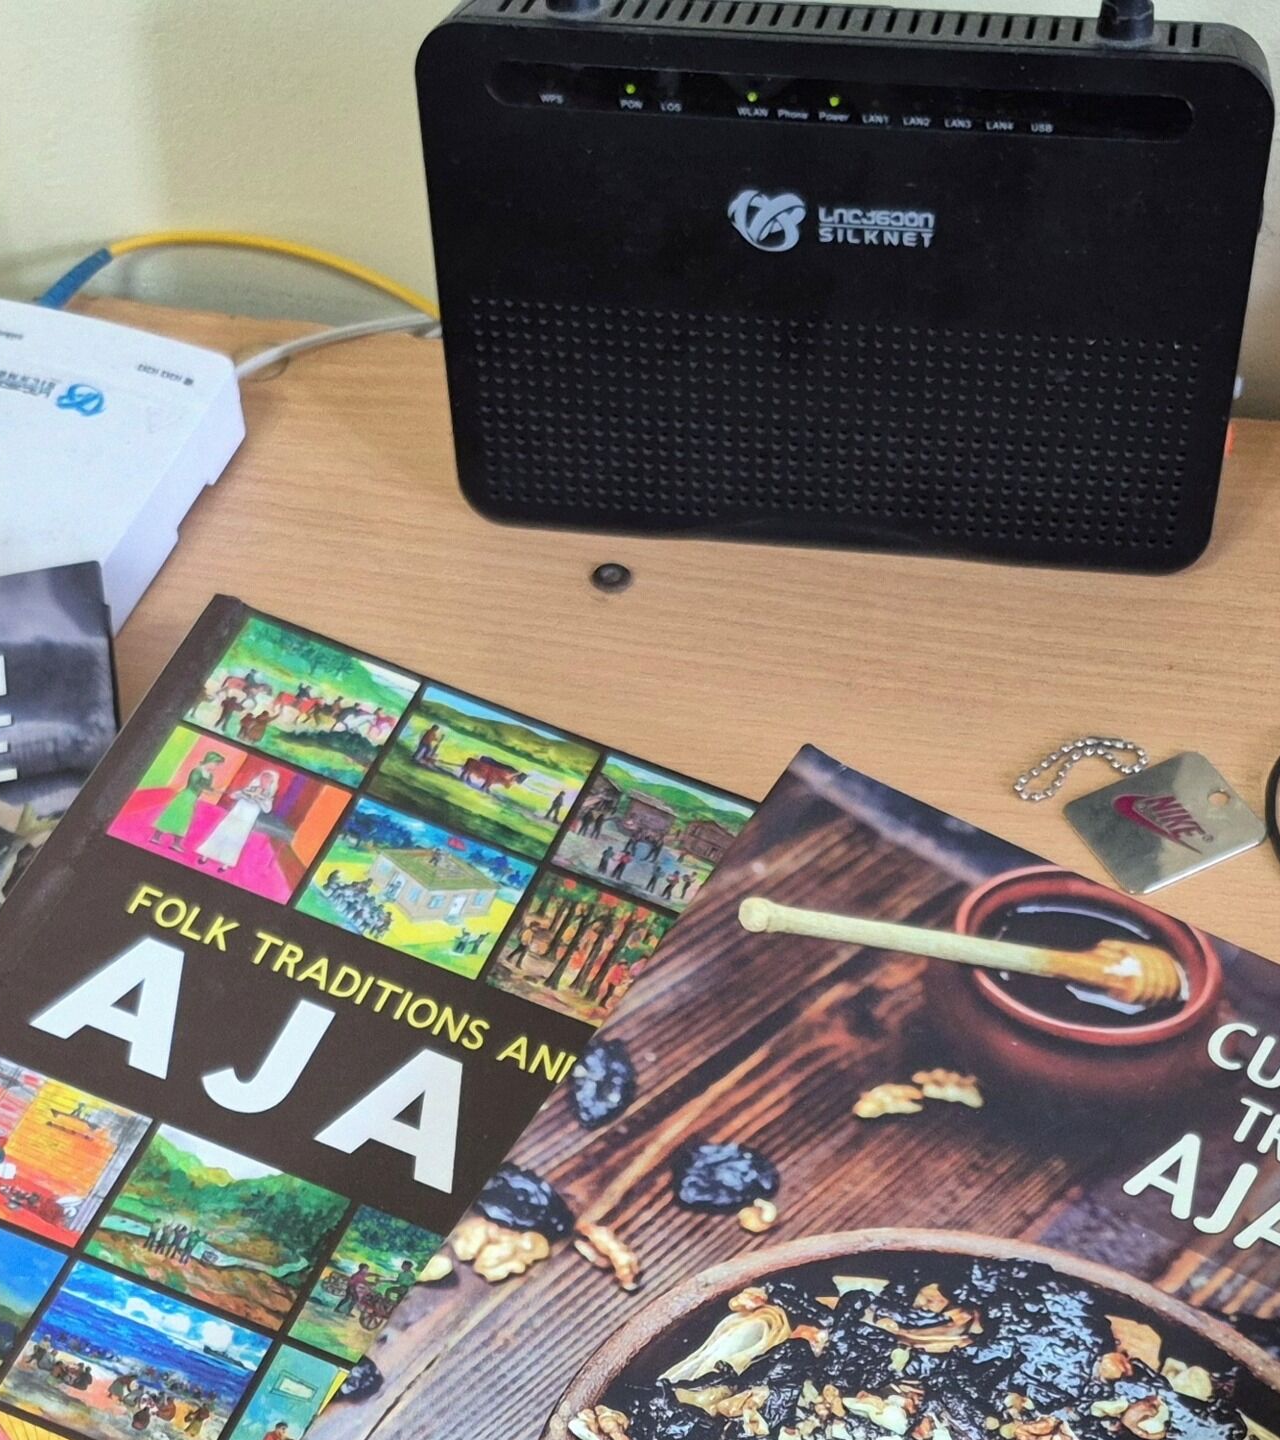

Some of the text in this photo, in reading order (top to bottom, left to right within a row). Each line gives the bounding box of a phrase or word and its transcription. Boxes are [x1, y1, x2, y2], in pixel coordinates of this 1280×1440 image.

[736, 106, 769, 118] WLAN
[777, 108, 809, 120] Phone
[818, 111, 850, 122] Power
[1030, 122, 1054, 134] USB
[818, 228, 935, 248] SILKNET
[1145, 795, 1207, 842] NIKE
[127, 885, 240, 951] FOLK
[251, 931, 490, 1051] TRADITIONS
